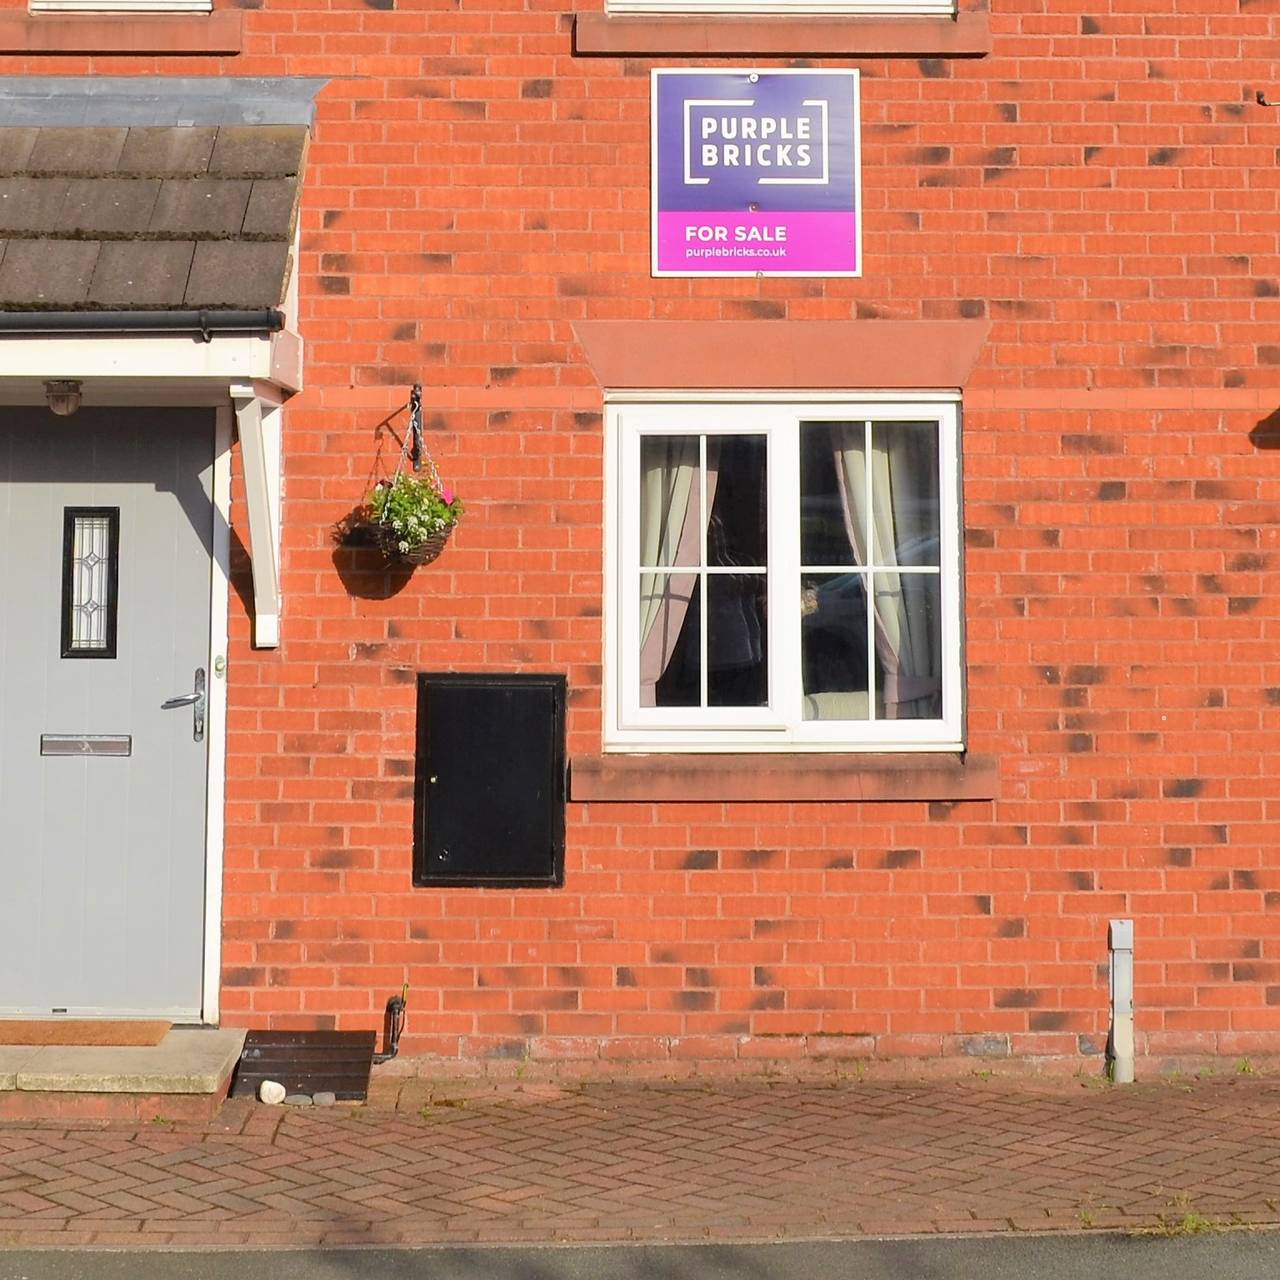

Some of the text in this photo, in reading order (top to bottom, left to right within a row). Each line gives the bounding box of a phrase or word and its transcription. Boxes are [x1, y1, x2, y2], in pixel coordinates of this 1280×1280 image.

[701, 117, 811, 140] PURPLE
[701, 144, 811, 167] BRICKS
[685, 225, 787, 242] FOR SALE
[685, 246, 787, 259] purplebricks.co.uk
